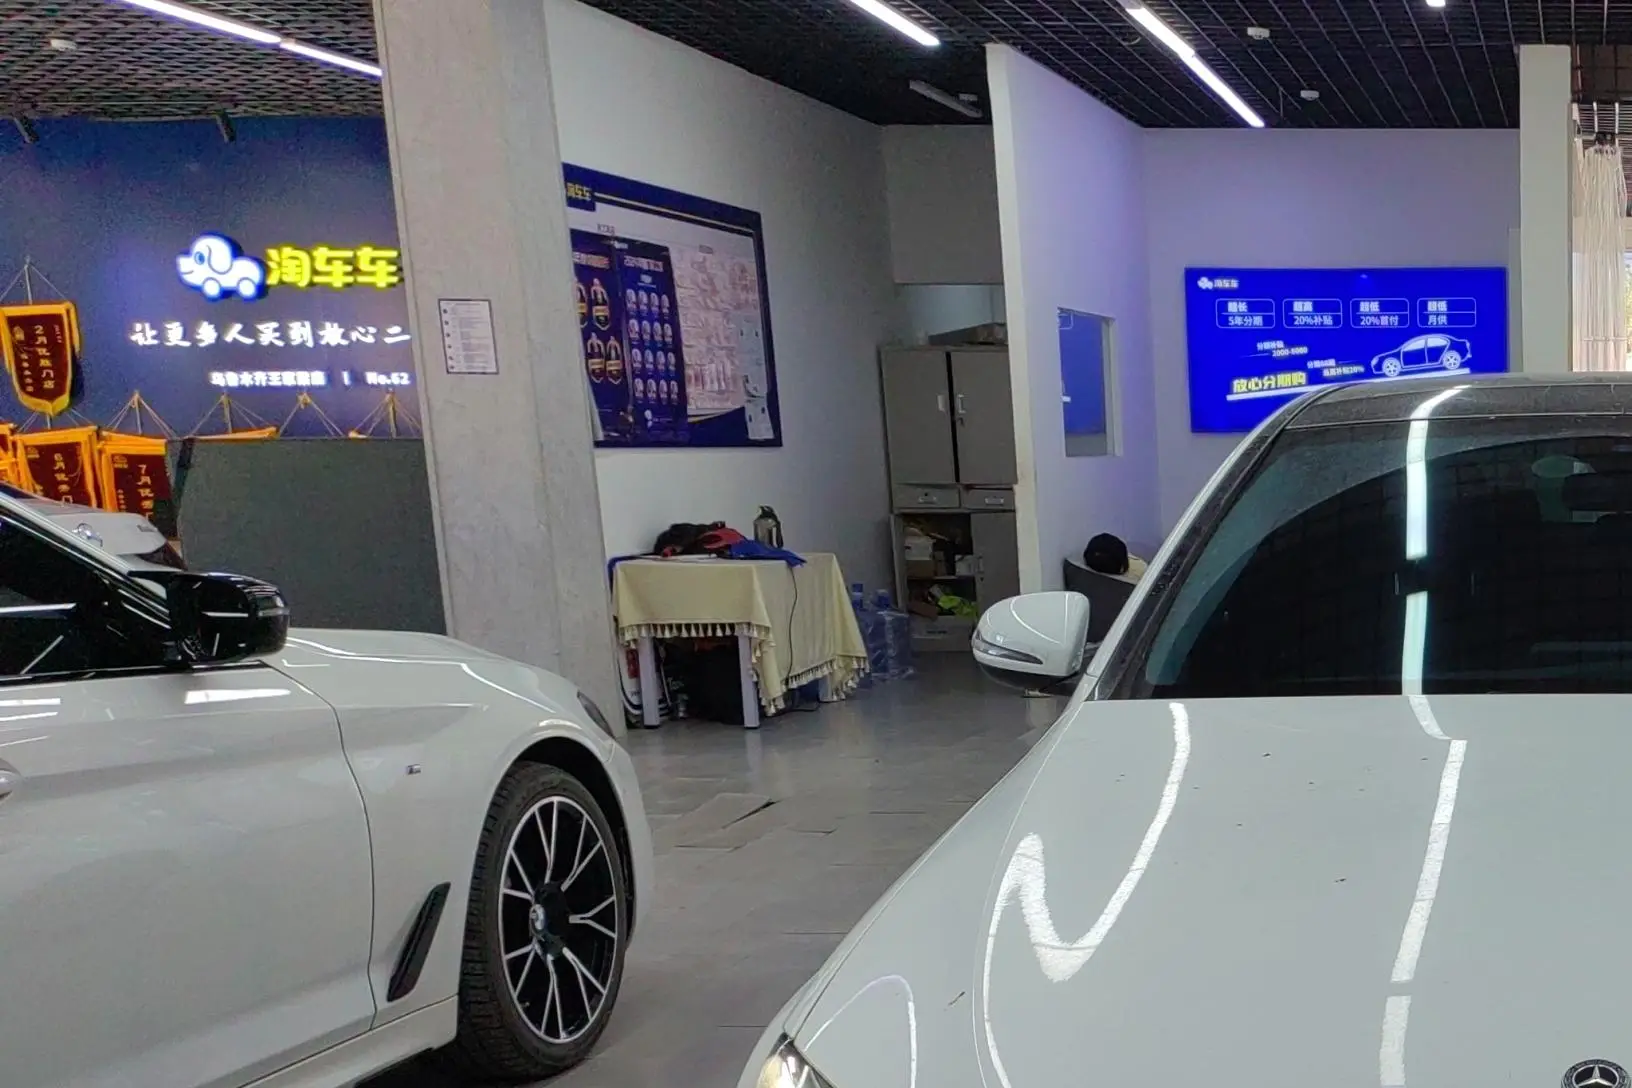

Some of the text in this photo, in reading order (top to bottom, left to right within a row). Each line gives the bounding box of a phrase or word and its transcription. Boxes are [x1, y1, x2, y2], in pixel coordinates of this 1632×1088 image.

[265, 246, 399, 288] 淘车车
[1360, 301, 1380, 313] 超低
[1427, 300, 1448, 312] 超低
[1228, 315, 1264, 327] 5年分期
[1293, 315, 1334, 327] 20%补贴
[1360, 315, 1399, 327] 20%首付
[1428, 314, 1449, 326] 月供
[130, 320, 411, 348] 让更多人买到放心二
[1233, 372, 1306, 393] 放心分期购
